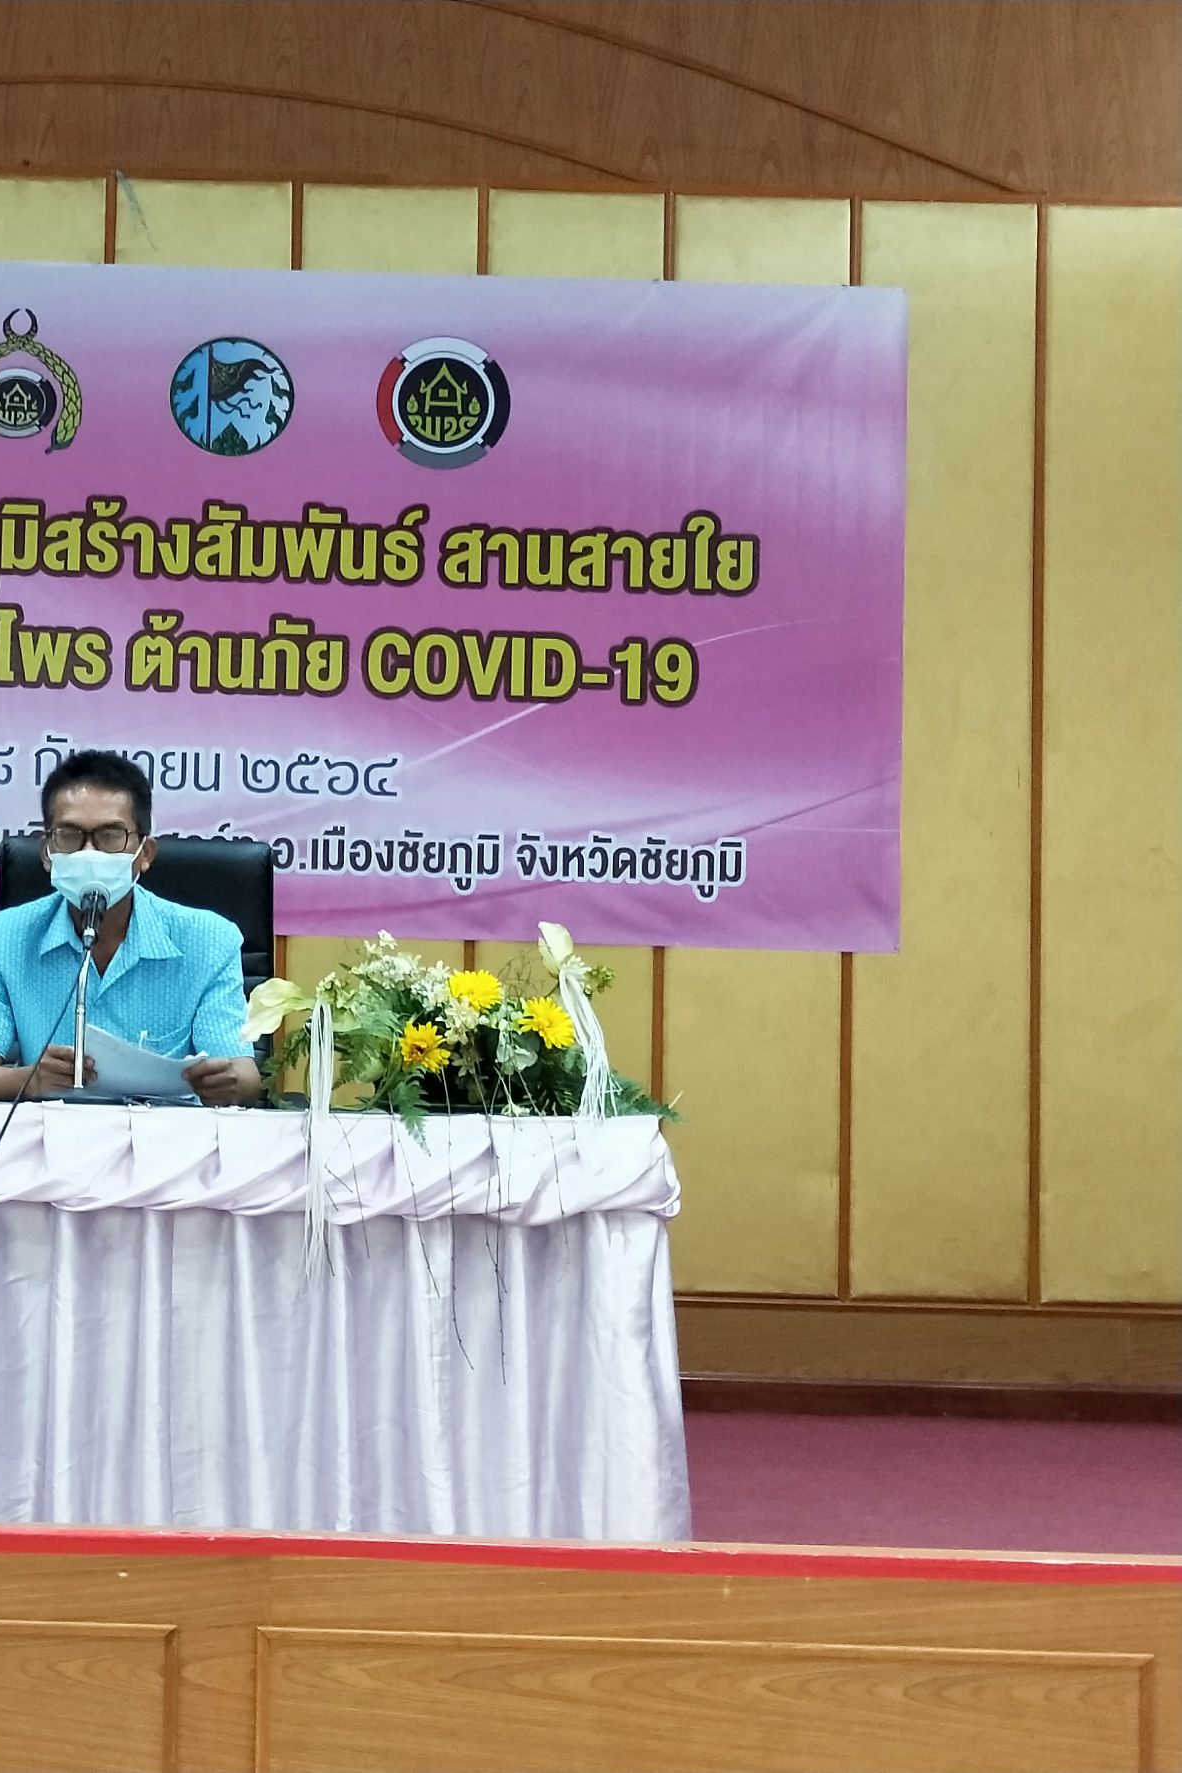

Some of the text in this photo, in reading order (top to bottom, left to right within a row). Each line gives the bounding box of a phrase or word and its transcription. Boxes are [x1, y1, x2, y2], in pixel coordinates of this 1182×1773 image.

[439, 512, 760, 594] สานสายใย
[124, 609, 349, 698] ต้านภัย
[361, 627, 699, 706] COVID-19
[34, 733, 221, 793] กัายน
[240, 750, 399, 798] ๒๕๖๔
[271, 824, 502, 892] อ.เมืองชัยภูมิ
[517, 832, 744, 898] จังหวัดชัยภูมิ
